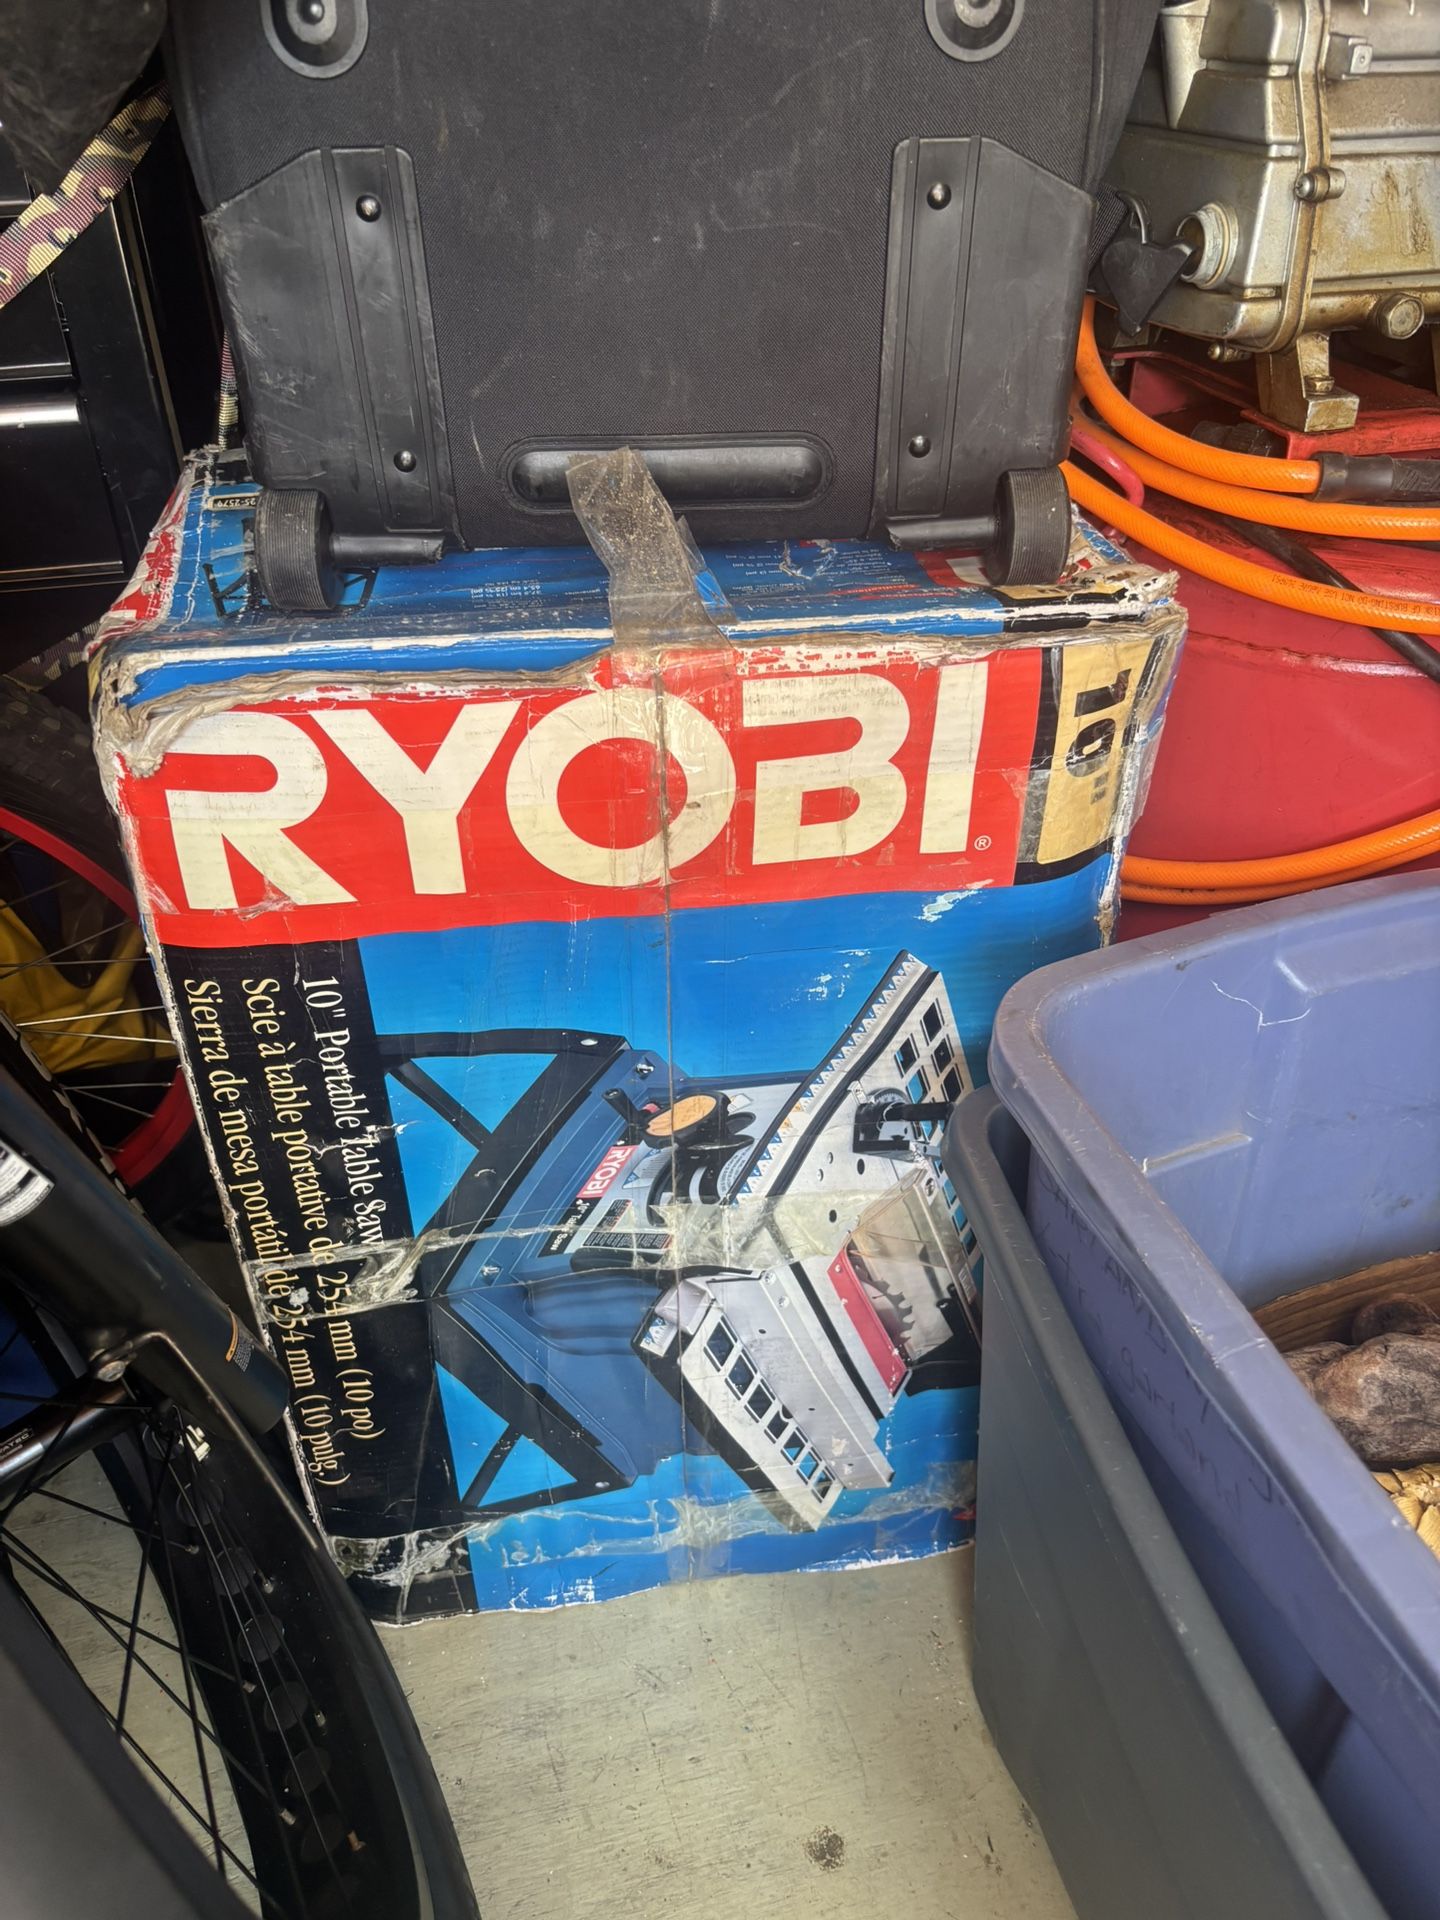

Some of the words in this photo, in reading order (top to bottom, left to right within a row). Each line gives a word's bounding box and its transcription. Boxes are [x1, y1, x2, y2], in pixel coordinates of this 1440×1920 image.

[241, 978, 286, 1035] Scie
[302, 975, 347, 1019] 10"
[183, 978, 230, 1063] Sierra
[257, 1041, 297, 1058] à
[208, 1069, 249, 1103] de
[264, 1063, 312, 1124] table
[314, 1028, 370, 1130] Portable
[218, 1109, 261, 1177] mesa
[340, 1132, 384, 1197] Table
[271, 1128, 331, 1231] portative
[582, 1148, 632, 1195] RYOBI
[229, 1178, 295, 1266] portátil
[353, 1199, 386, 1247] Saw
[308, 1236, 344, 1265] de
[263, 1268, 300, 1298] de
[316, 1271, 352, 1316] 254
[272, 1303, 316, 1344] 254
[328, 1320, 358, 1362] mm
[286, 1347, 317, 1389] mm
[336, 1368, 374, 1402] (10
[294, 1394, 334, 1429] (10
[340, 1408, 387, 1440] po)
[299, 1432, 351, 1486] pulg.)
